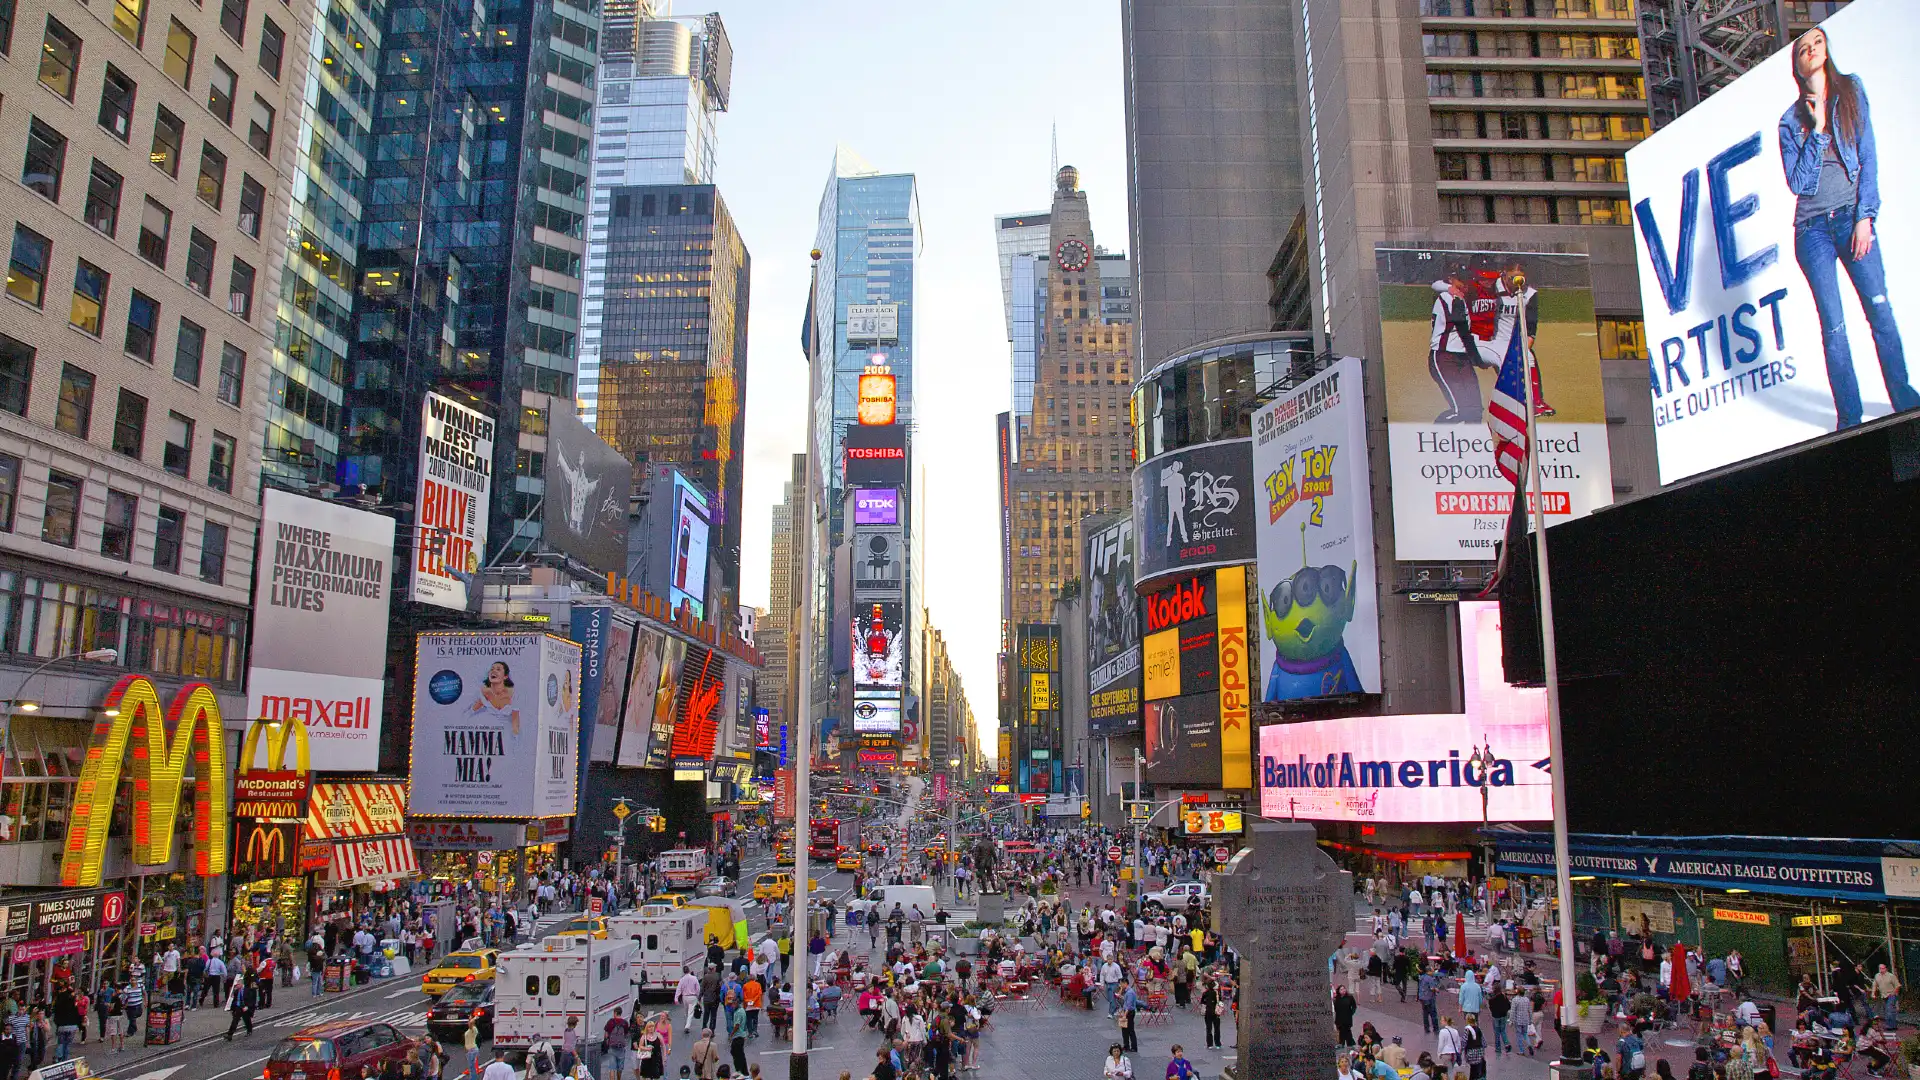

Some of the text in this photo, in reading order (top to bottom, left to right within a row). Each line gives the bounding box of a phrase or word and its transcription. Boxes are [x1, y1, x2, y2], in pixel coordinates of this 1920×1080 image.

[864, 366, 891, 374] 2009
[1687, 356, 1797, 416] OUTFITTERS
[1257, 371, 1340, 435] 3D DOUBLE EVENT
[1276, 417, 1299, 437] THEATRES
[1336, 393, 1341, 404] 2
[430, 397, 493, 442] WINNER
[1274, 406, 1298, 426] FEATURE
[443, 424, 479, 453] BEST
[425, 436, 490, 477] MUSICAL
[848, 448, 904, 459] TOSHIBA
[1301, 444, 1339, 479] TOY
[429, 457, 485, 493] 2009 TONY AWARD
[1264, 453, 1296, 501] TOY
[1420, 463, 1503, 484] oppone
[1303, 481, 1331, 493] STORY
[422, 479, 469, 535] BILLY
[467, 495, 477, 524] MUSICAL
[867, 500, 894, 508] TDK
[1271, 487, 1295, 516] STORY
[1310, 494, 1324, 528] 2
[1440, 494, 1566, 512] SPORTSMSHIP
[278, 522, 331, 548] WHERE
[1192, 527, 1235, 541] Sheckler
[1473, 519, 1498, 530] Pass
[275, 541, 383, 583] MAXIMUM
[1090, 520, 1133, 580] UFC
[272, 565, 381, 599] PERFORMANCE
[271, 584, 325, 612] LIVES
[1147, 578, 1207, 630] Kodak
[437, 647, 446, 655] IS
[447, 647, 454, 655] A
[449, 636, 498, 646] FEEL-GOOD
[500, 636, 539, 646] MUSICAL
[590, 609, 600, 677] VORNADO
[1149, 655, 1175, 680] smile?
[1221, 626, 1247, 731] Kodak
[1033, 686, 1047, 695] LION
[1033, 696, 1047, 704] KING
[1101, 687, 1138, 706] SEPTEMBER 19
[260, 695, 370, 729] maxell
[1090, 702, 1138, 718] LIVE ON PAY-PER-VIEW
[289, 729, 368, 740] ww.maxell.com
[443, 730, 505, 756] MAMMA
[548, 730, 568, 755] MAMMA
[455, 757, 492, 782] MIA!
[551, 756, 564, 779] MIA!
[1339, 750, 1514, 788] America
[237, 779, 305, 790] McDonald's
[1357, 808, 1375, 816] cure.
[1500, 851, 1637, 871] AMERICAN EAE OUTFITTERS
[1667, 860, 1873, 887] AMERICAN EAGLE OUTFITTERS
[39, 896, 96, 913] TIMES SQUARE
[1716, 910, 1766, 922] NEWSSTAND
[8, 917, 28, 926] SQUARE
[39, 908, 92, 926] INFORMATION
[50, 922, 80, 935] CENTER
[1793, 915, 1839, 926] NEWSSAND
[41, 1062, 75, 1078] PRIVATE EYES
